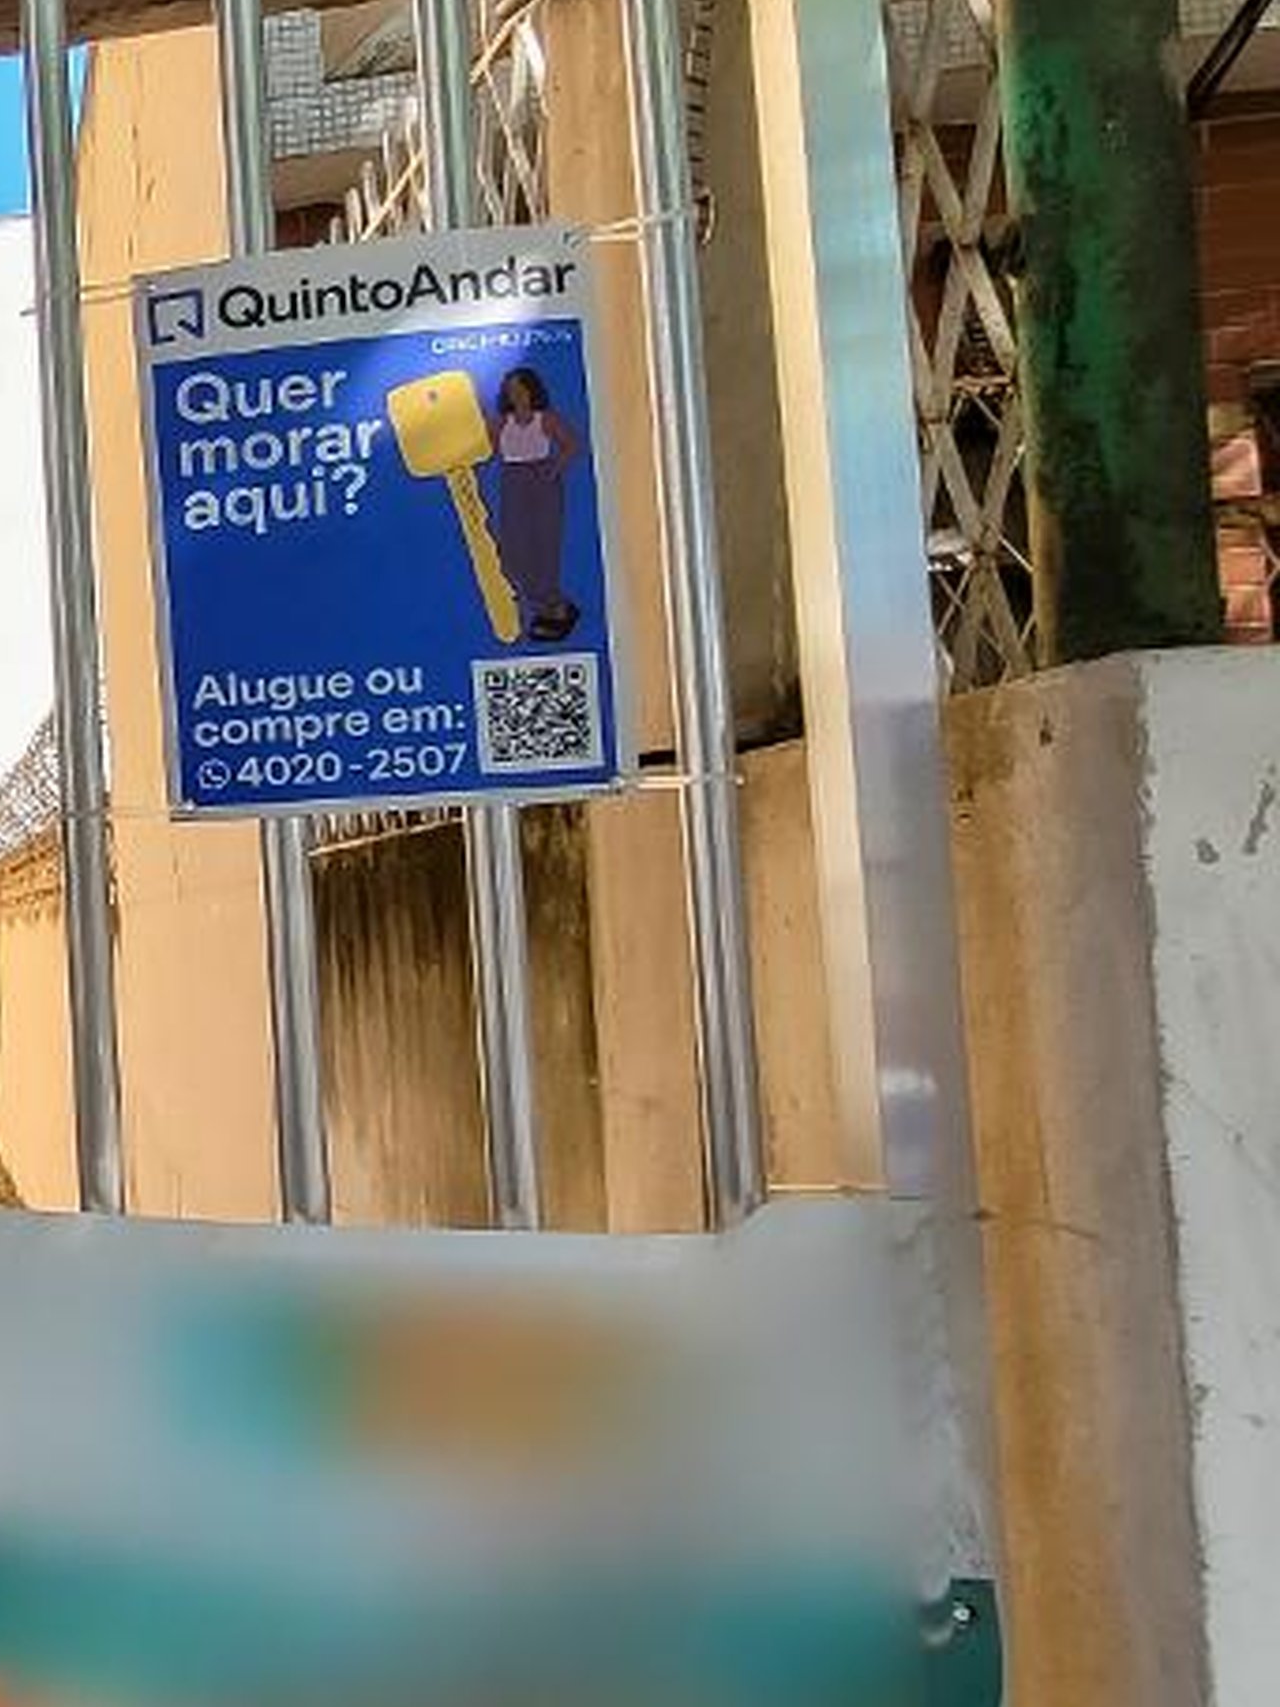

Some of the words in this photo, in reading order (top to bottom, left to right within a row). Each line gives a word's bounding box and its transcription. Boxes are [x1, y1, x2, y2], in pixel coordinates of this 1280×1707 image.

[217, 255, 578, 330] QuintoAndar
[175, 368, 347, 425] Quer
[179, 418, 383, 478] morar
[183, 465, 370, 535] aqui?
[192, 670, 356, 712] Alugue
[365, 666, 424, 696] ou
[193, 707, 372, 750] compre
[381, 700, 466, 734] em:
